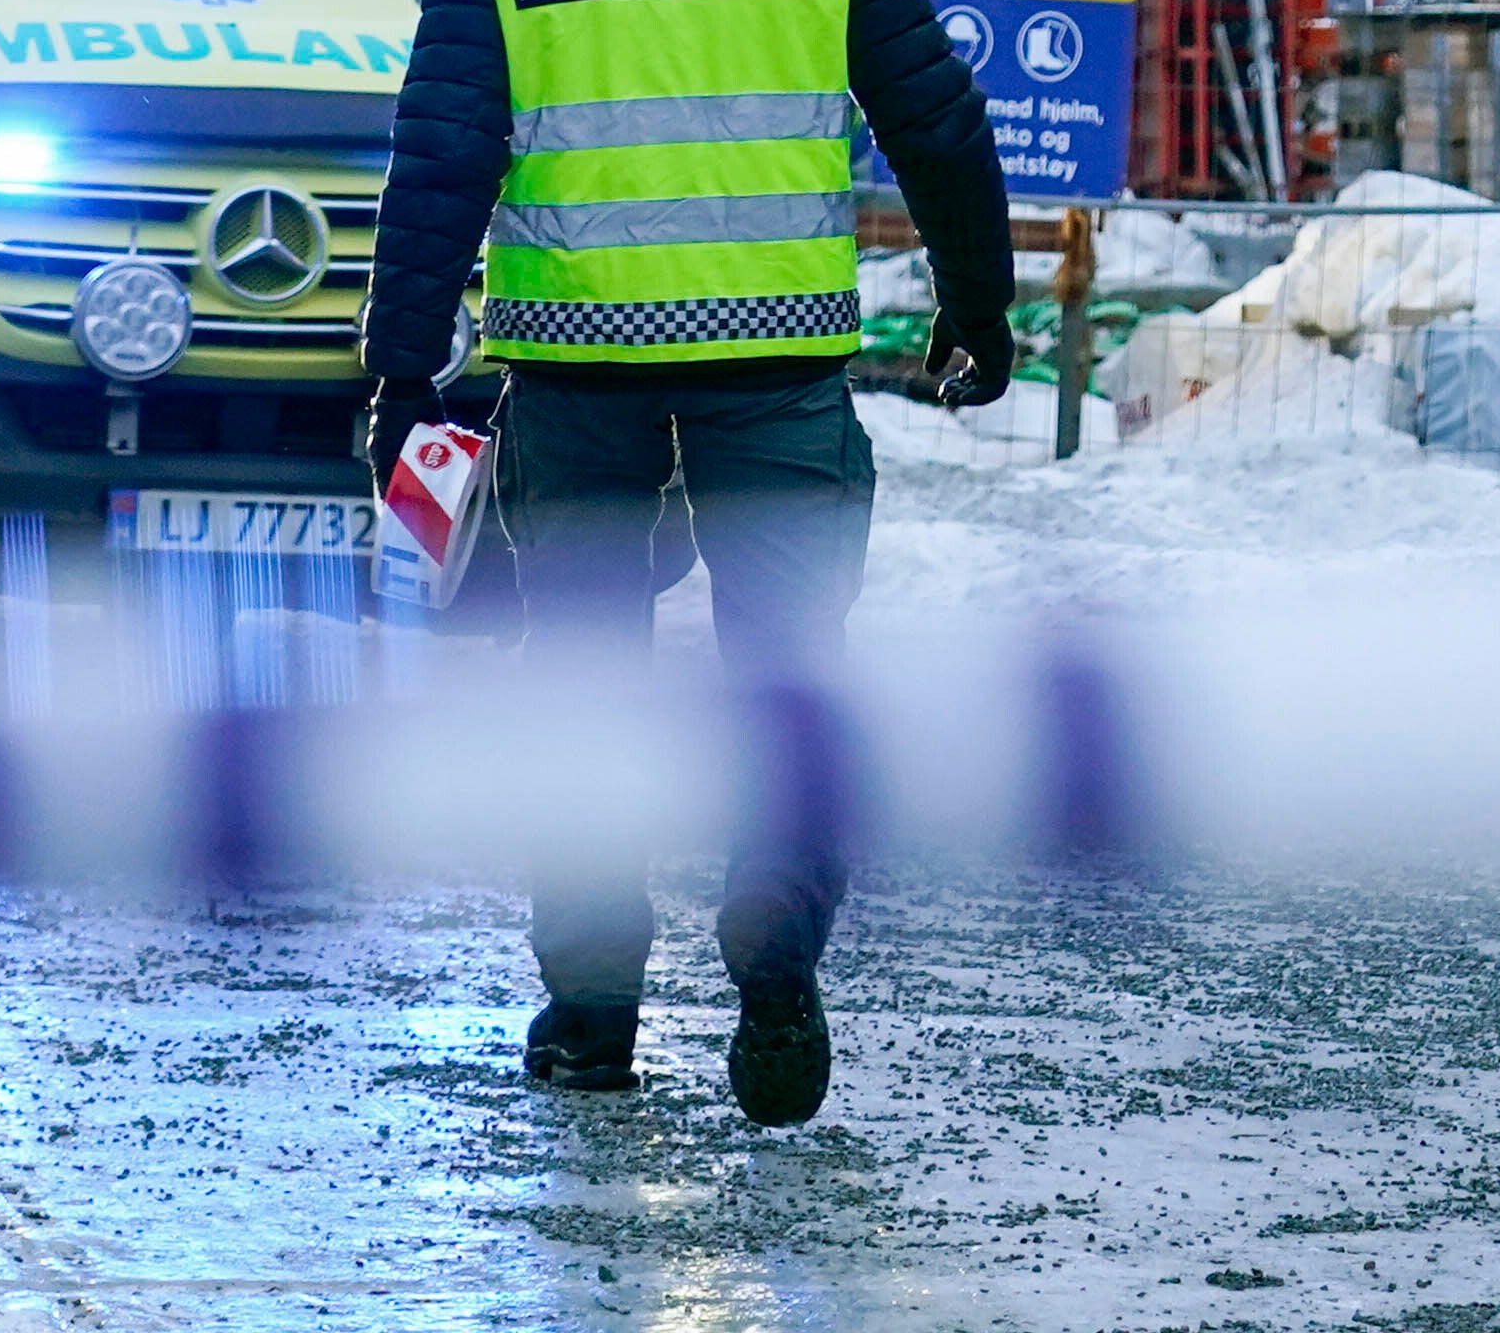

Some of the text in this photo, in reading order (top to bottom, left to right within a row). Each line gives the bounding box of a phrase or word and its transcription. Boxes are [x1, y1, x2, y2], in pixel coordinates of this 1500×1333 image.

[1039, 96, 1105, 127] hjelm,
[993, 123, 1071, 154] sko og
[160, 498, 377, 549] LJ 77732
